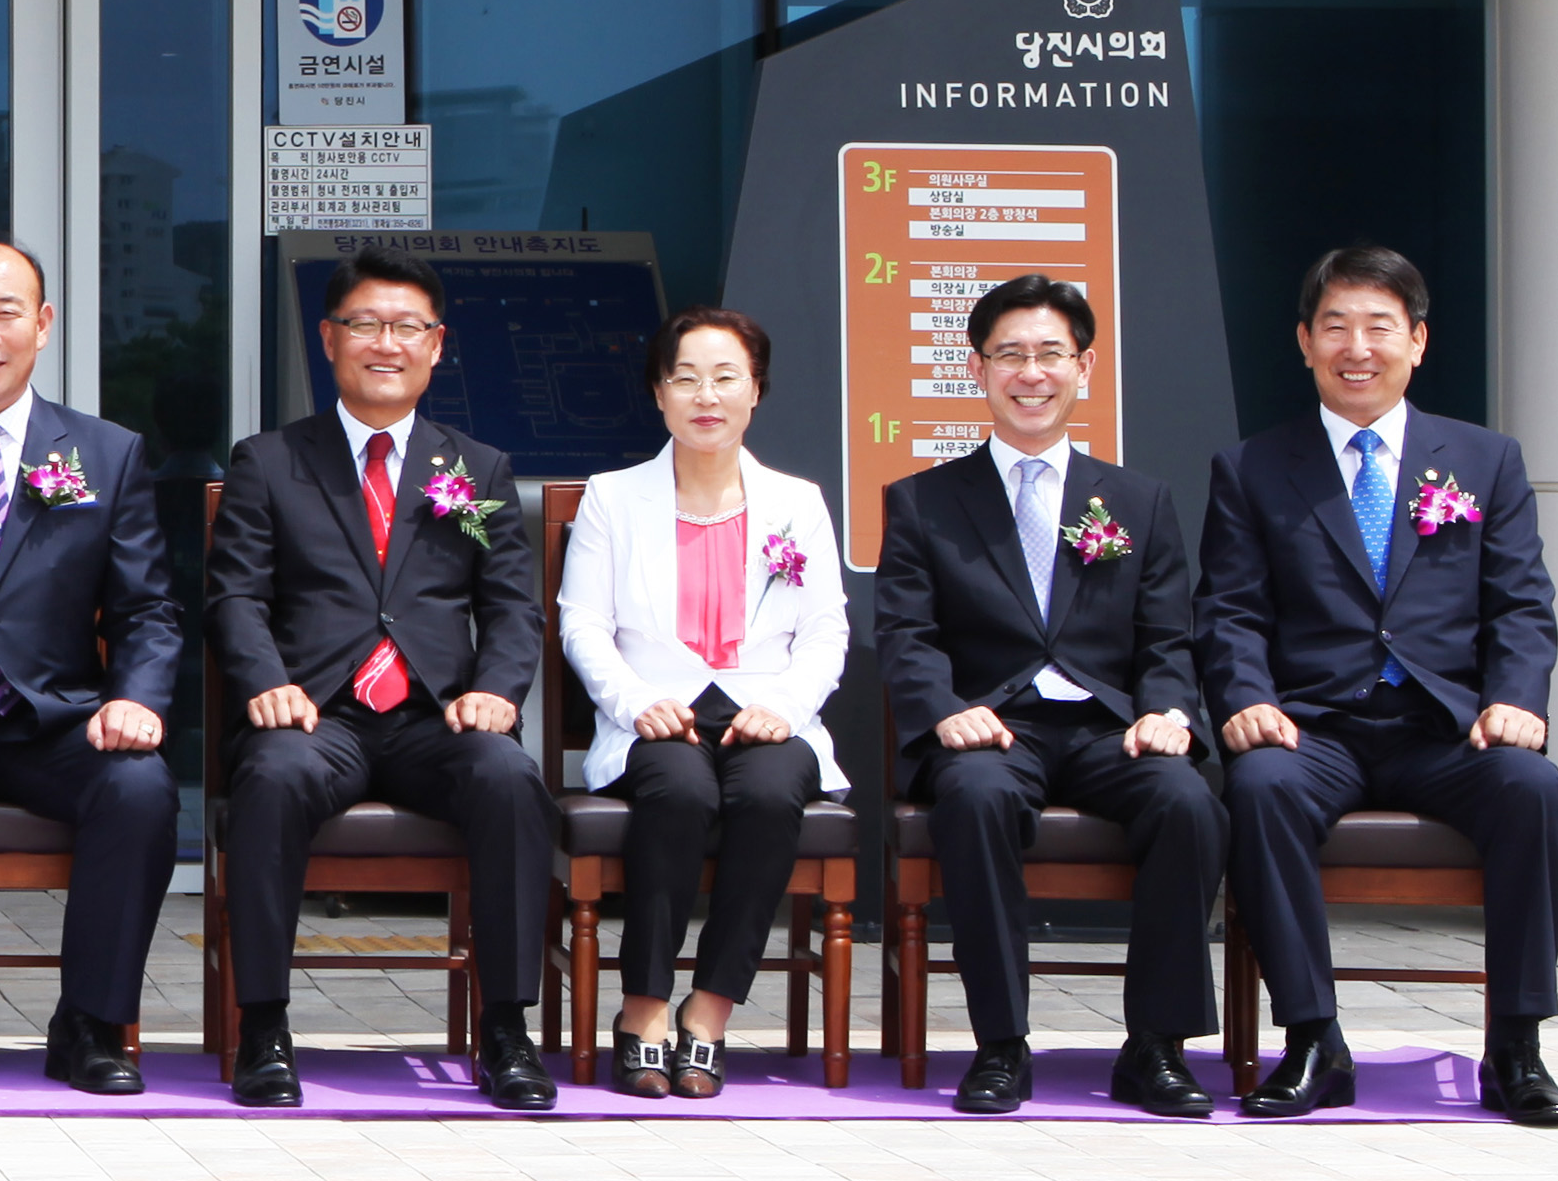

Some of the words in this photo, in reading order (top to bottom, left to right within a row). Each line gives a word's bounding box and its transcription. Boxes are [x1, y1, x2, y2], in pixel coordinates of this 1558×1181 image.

[1015, 31, 1167, 69] 당진시의회
[298, 55, 386, 76] 금연시설
[334, 96, 366, 107] 당진시
[900, 82, 1170, 108] INFORMATION
[274, 131, 422, 148] CCTV설치안내
[317, 152, 366, 165] 청사보안용
[371, 152, 401, 163] CCTV
[271, 169, 309, 181] 촬영시간
[317, 168, 349, 181] 24시간
[863, 161, 897, 192] 3F
[928, 174, 988, 187] 의원사무실
[271, 185, 310, 198] 촬영범위
[317, 185, 336, 198] 청내
[341, 185, 371, 197] 전지역
[375, 185, 384, 198] 및
[389, 185, 419, 197] 출입자
[930, 191, 964, 203] 상담실
[270, 202, 310, 214] 관리부서
[317, 201, 346, 214] 회계과
[352, 201, 401, 214] 청사관리팀
[929, 208, 977, 220] 본회의장
[980, 209, 1000, 221] 2층
[1002, 209, 1038, 221] 방청석
[930, 224, 965, 237] 방송실
[474, 236, 602, 254] 안내촉지도
[864, 252, 899, 284] 2F
[930, 265, 978, 278] 본회의장
[931, 282, 965, 295] 의장실
[932, 316, 969, 328] 민원상
[931, 332, 972, 345] 전문위
[932, 349, 973, 361] 산업건
[931, 365, 975, 378] 총무위
[932, 383, 985, 395] 의회운영
[868, 412, 901, 443] 1F
[932, 425, 980, 438] 소회의실
